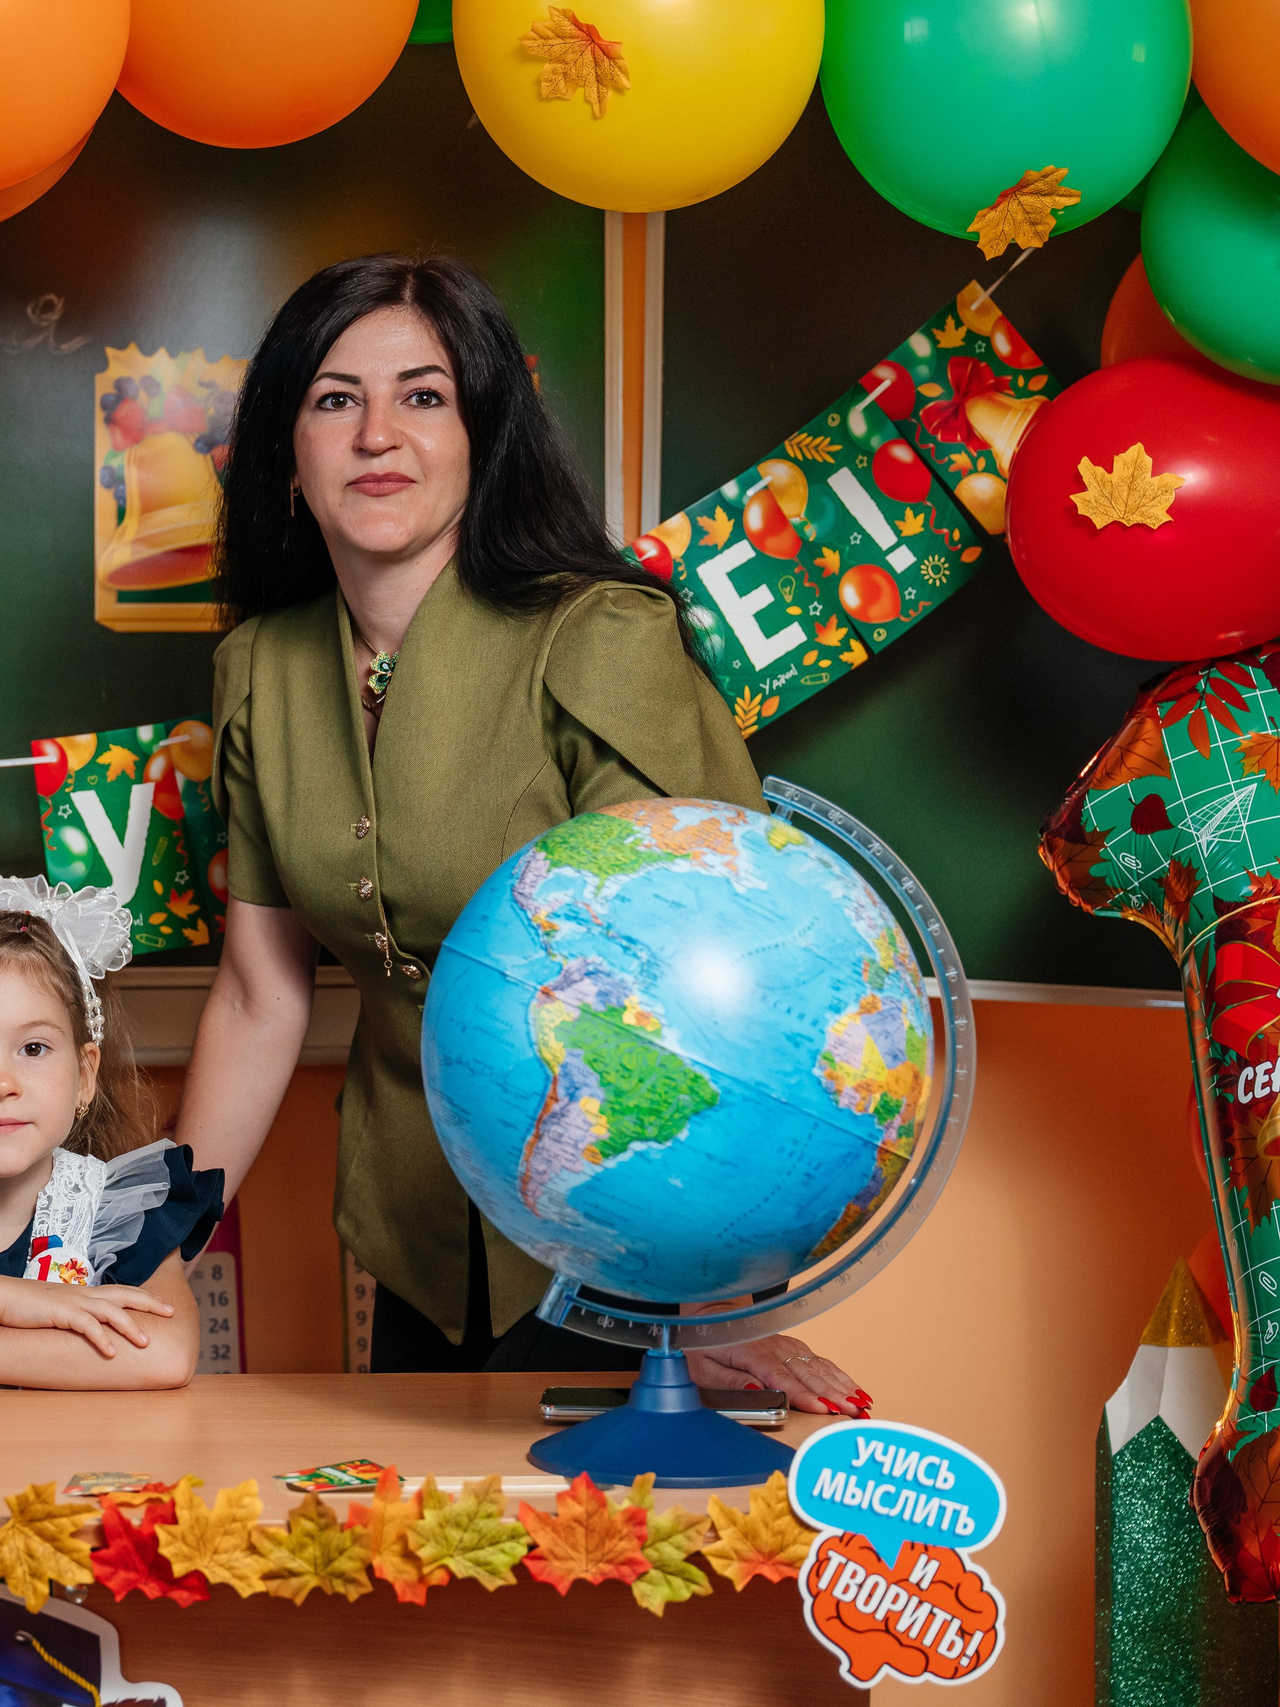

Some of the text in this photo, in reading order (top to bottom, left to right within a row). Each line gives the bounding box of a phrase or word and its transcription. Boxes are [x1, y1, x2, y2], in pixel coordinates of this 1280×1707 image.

[211, 1264, 223, 1281] 8
[208, 1291, 230, 1307] 16
[208, 1317, 231, 1334] 24
[209, 1344, 232, 1361] 32
[851, 1436, 956, 1490] УЧИСЬ
[812, 1467, 976, 1537] МЫСЛИТЬ
[907, 1552, 940, 1591] И
[817, 1549, 985, 1668] ТВОРИТЬ!
